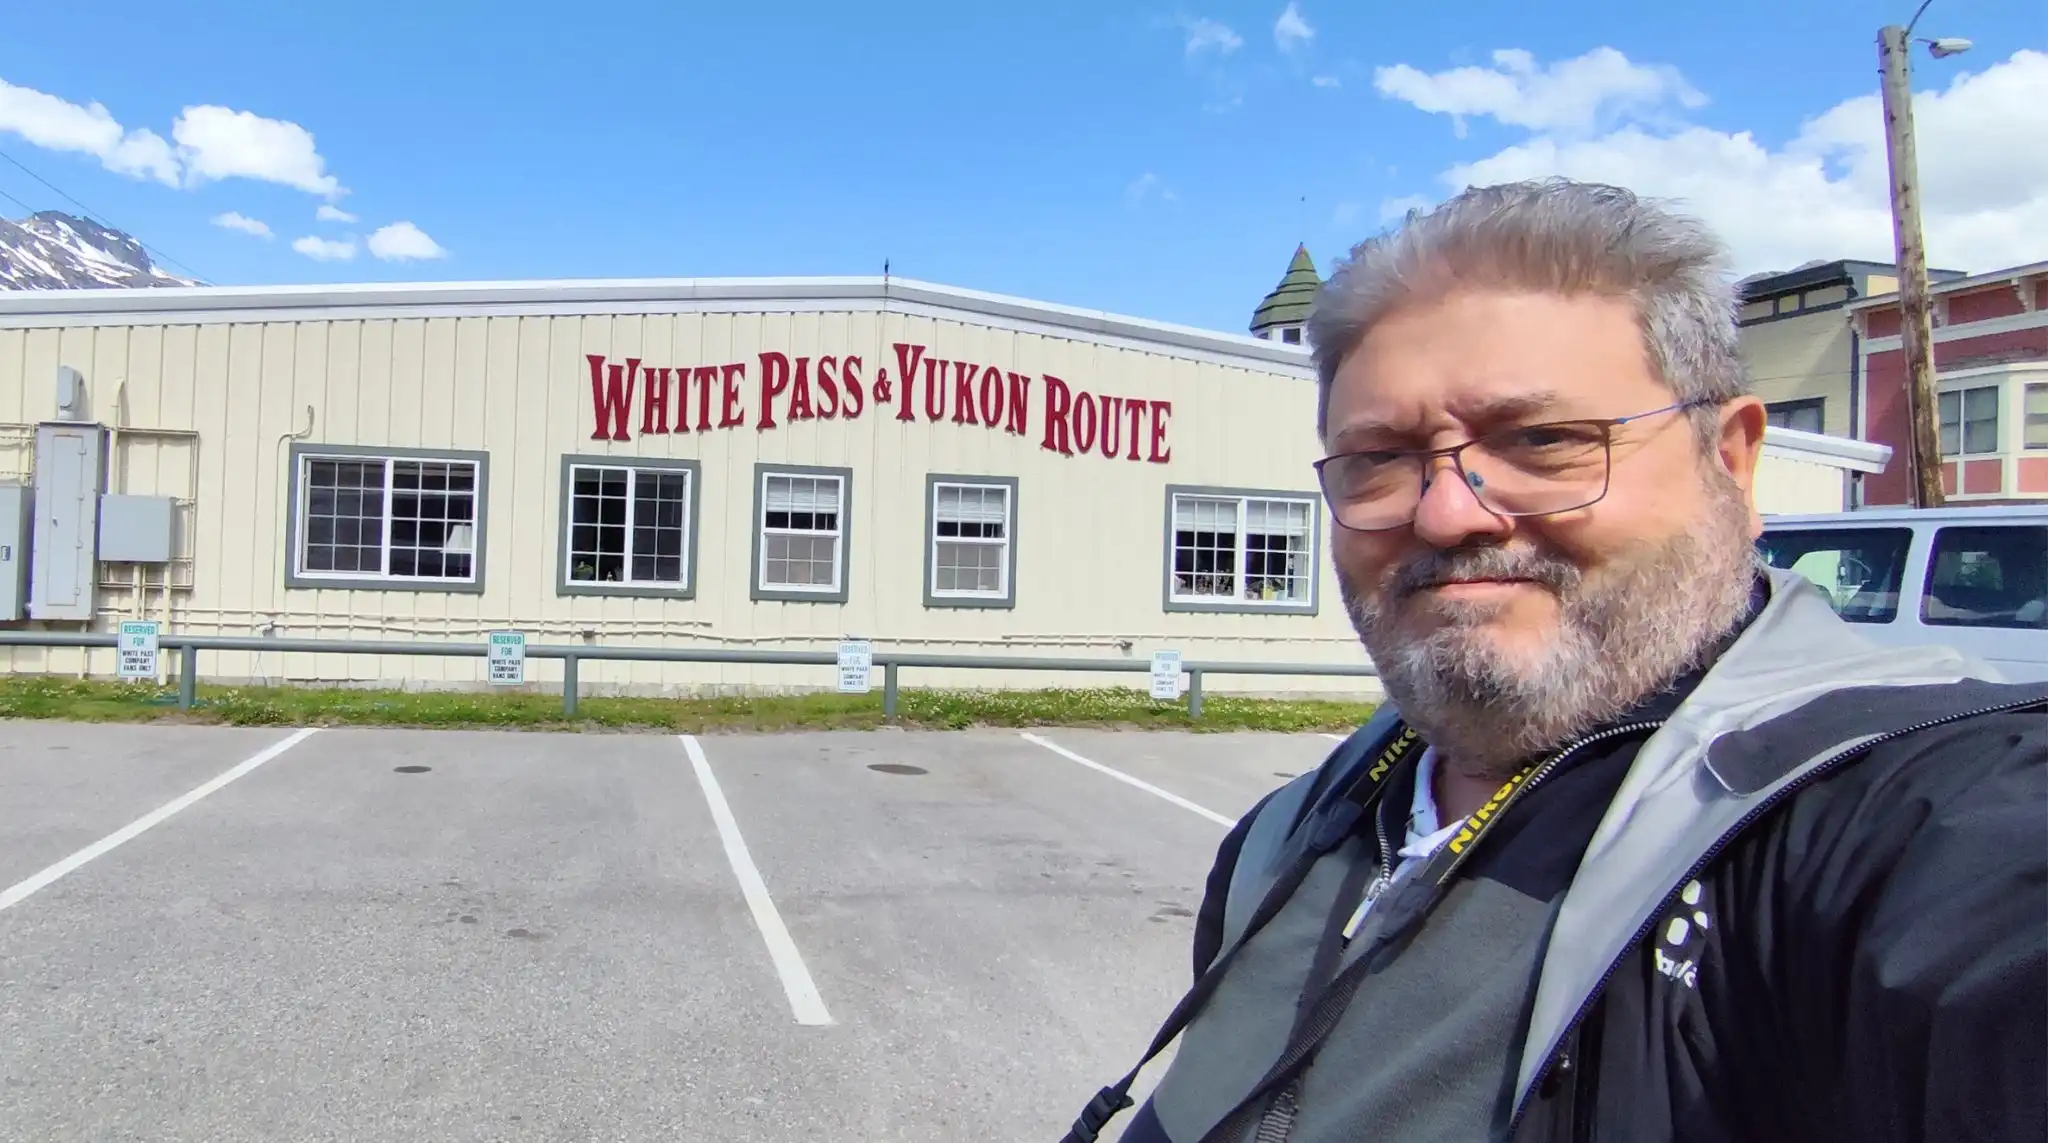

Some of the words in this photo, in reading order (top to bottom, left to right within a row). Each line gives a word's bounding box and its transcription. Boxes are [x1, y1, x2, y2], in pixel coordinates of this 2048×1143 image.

[586, 354, 746, 441] WHITE
[756, 351, 865, 431] PASS
[872, 368, 892, 402] &
[892, 342, 1031, 436] YUKON
[1041, 373, 1172, 463] ROUTE
[124, 625, 155, 635] RESERVED
[132, 637, 145, 646] FOR
[492, 635, 522, 645] RESERVED
[500, 646, 513, 656] FOR
[1369, 728, 1418, 783] NIKO
